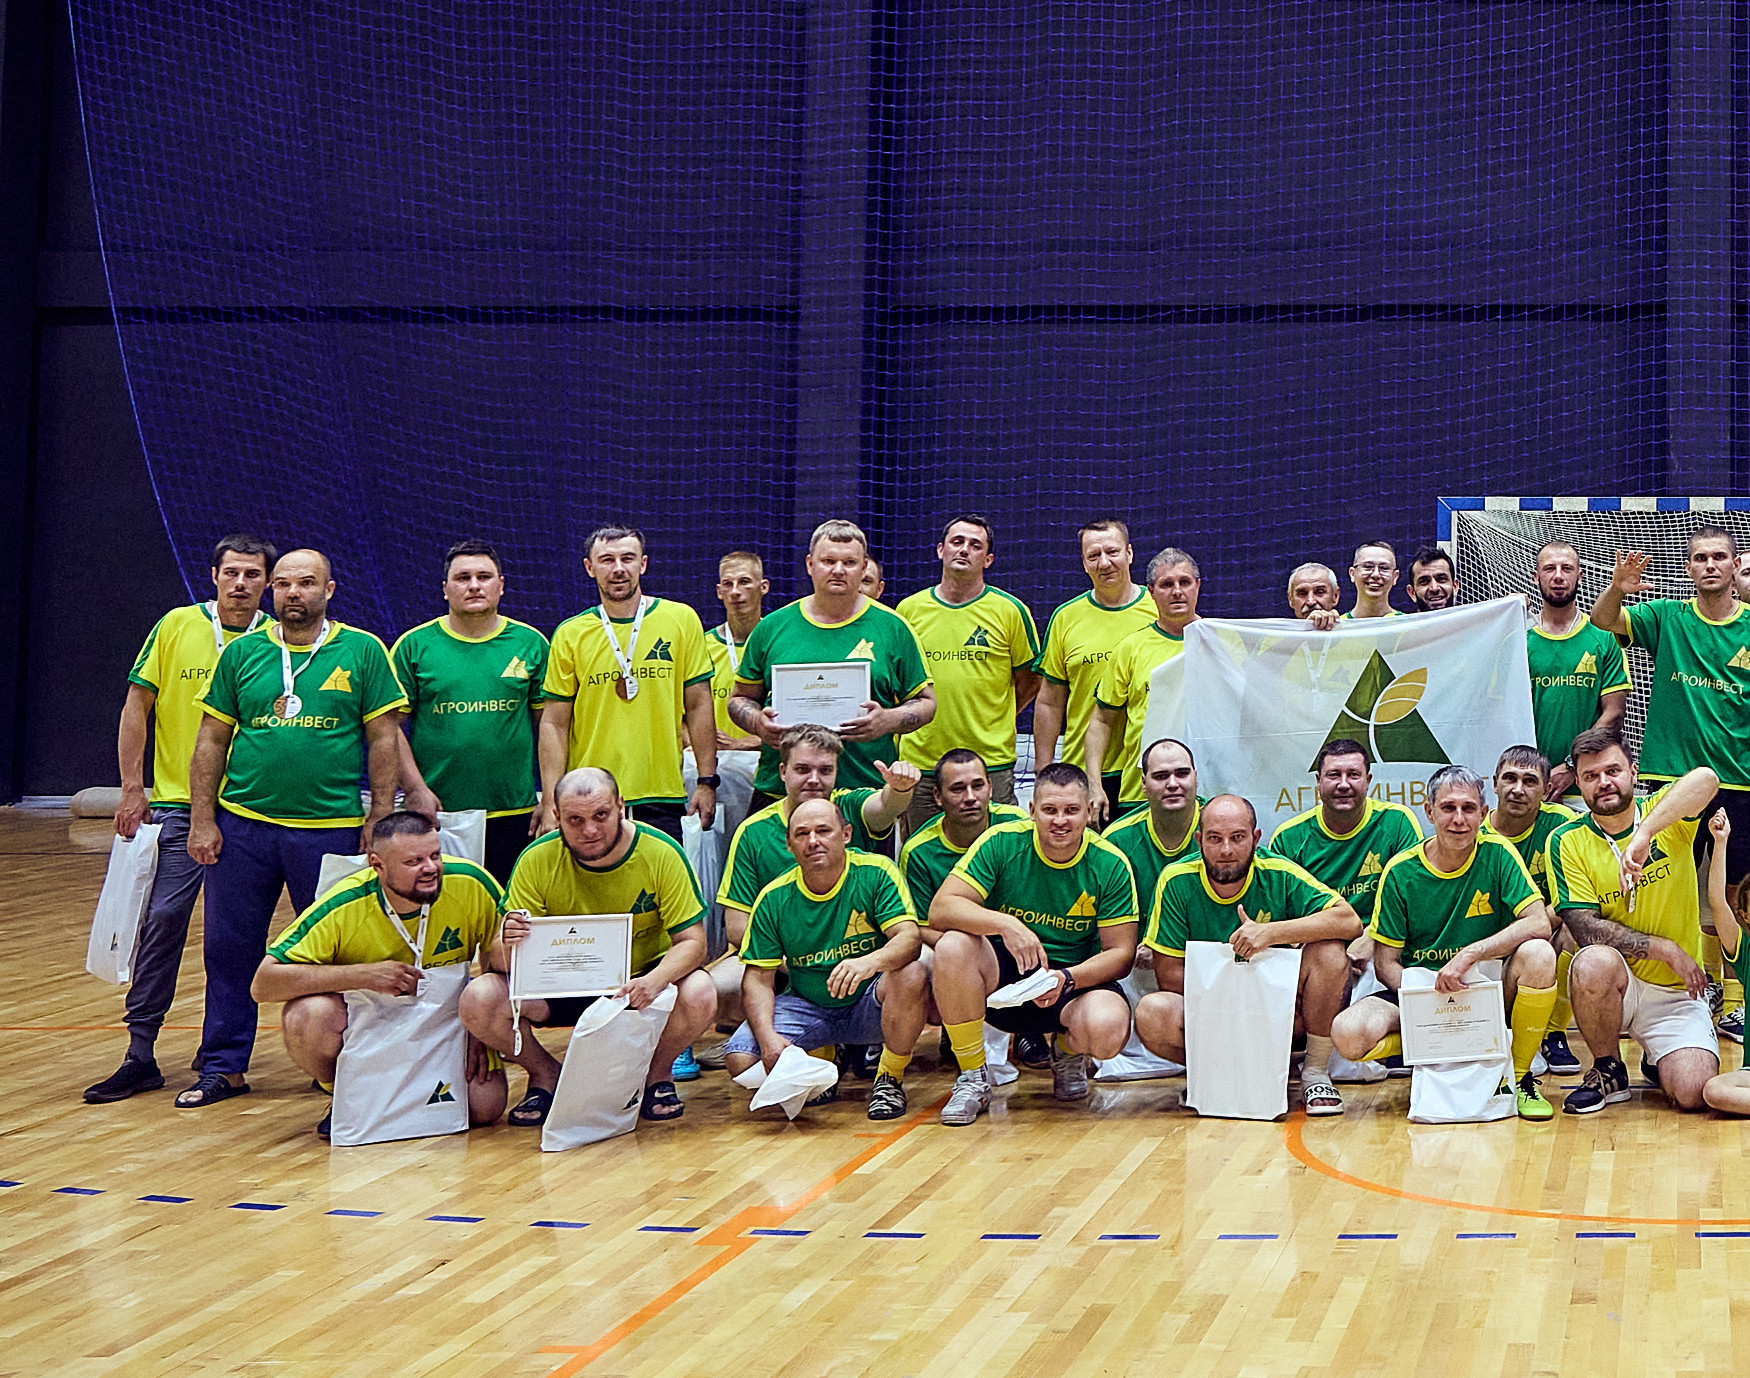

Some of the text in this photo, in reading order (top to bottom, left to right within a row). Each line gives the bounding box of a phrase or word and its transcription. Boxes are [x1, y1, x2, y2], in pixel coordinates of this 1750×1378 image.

[926, 651, 991, 662] РОИНВЕСТ
[588, 667, 673, 687] АГРОНВЕСТ
[1531, 675, 1596, 689] РОИНВЕСТ
[1671, 671, 1745, 695] АГРОИНВЕСТ
[432, 699, 521, 715] АГРОИНВЕСТ
[998, 904, 1092, 933] АГРОИНВЕСТ
[550, 937, 596, 947] ДИПЛОМ
[792, 937, 878, 967] АГРОИНВЕСТ
[1434, 1005, 1471, 1015] ДИПЛОМ
